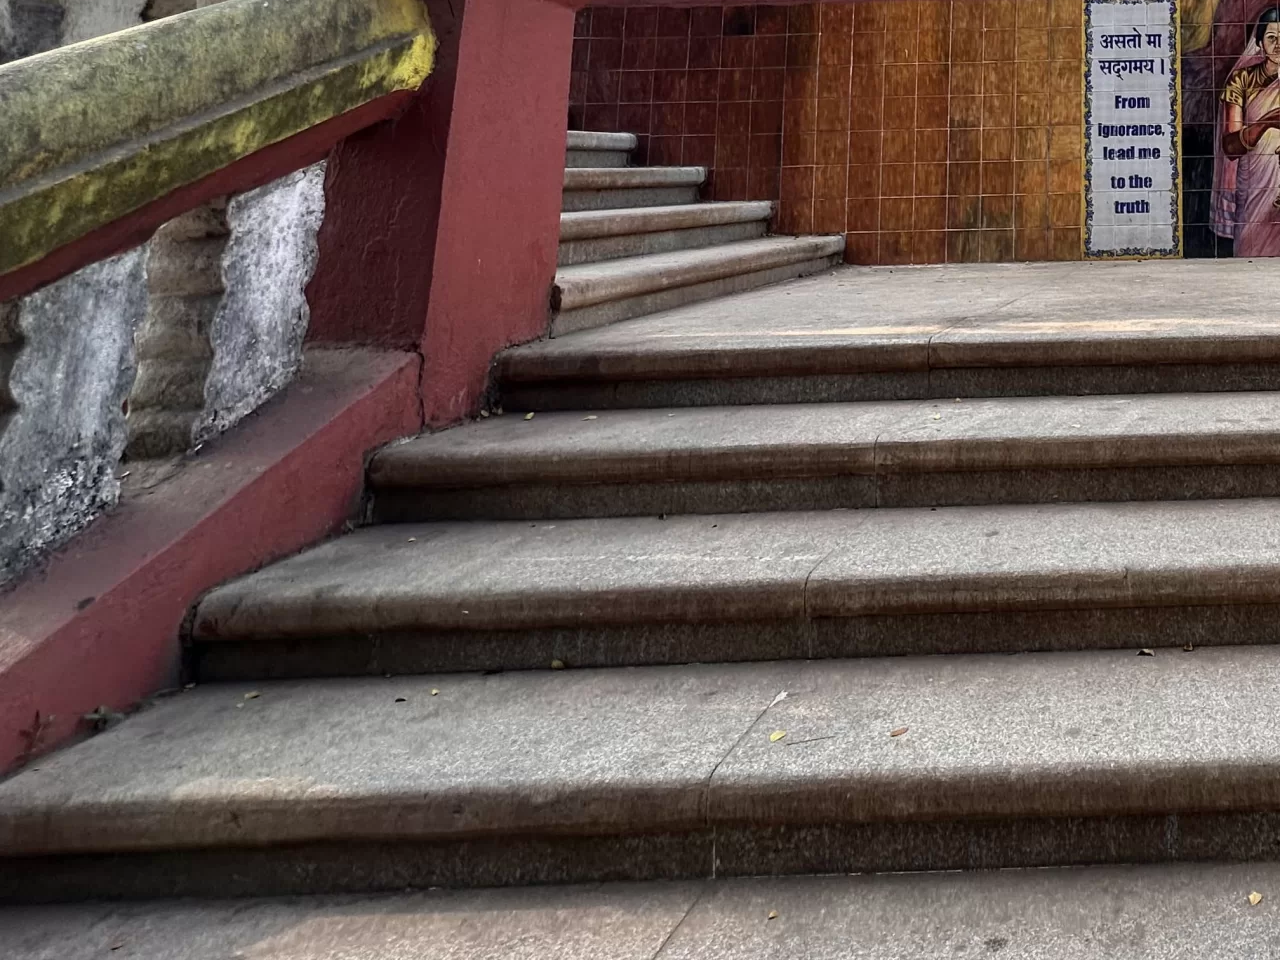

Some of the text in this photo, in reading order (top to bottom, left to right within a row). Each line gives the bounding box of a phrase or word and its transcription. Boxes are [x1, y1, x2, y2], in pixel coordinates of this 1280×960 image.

[1099, 26, 1162, 49] असतो मा
[1114, 95, 1151, 109] From
[1097, 123, 1165, 138] ignorance,
[1103, 146, 1161, 160] lead me
[1110, 174, 1153, 189] to the
[1114, 200, 1150, 214] truth
